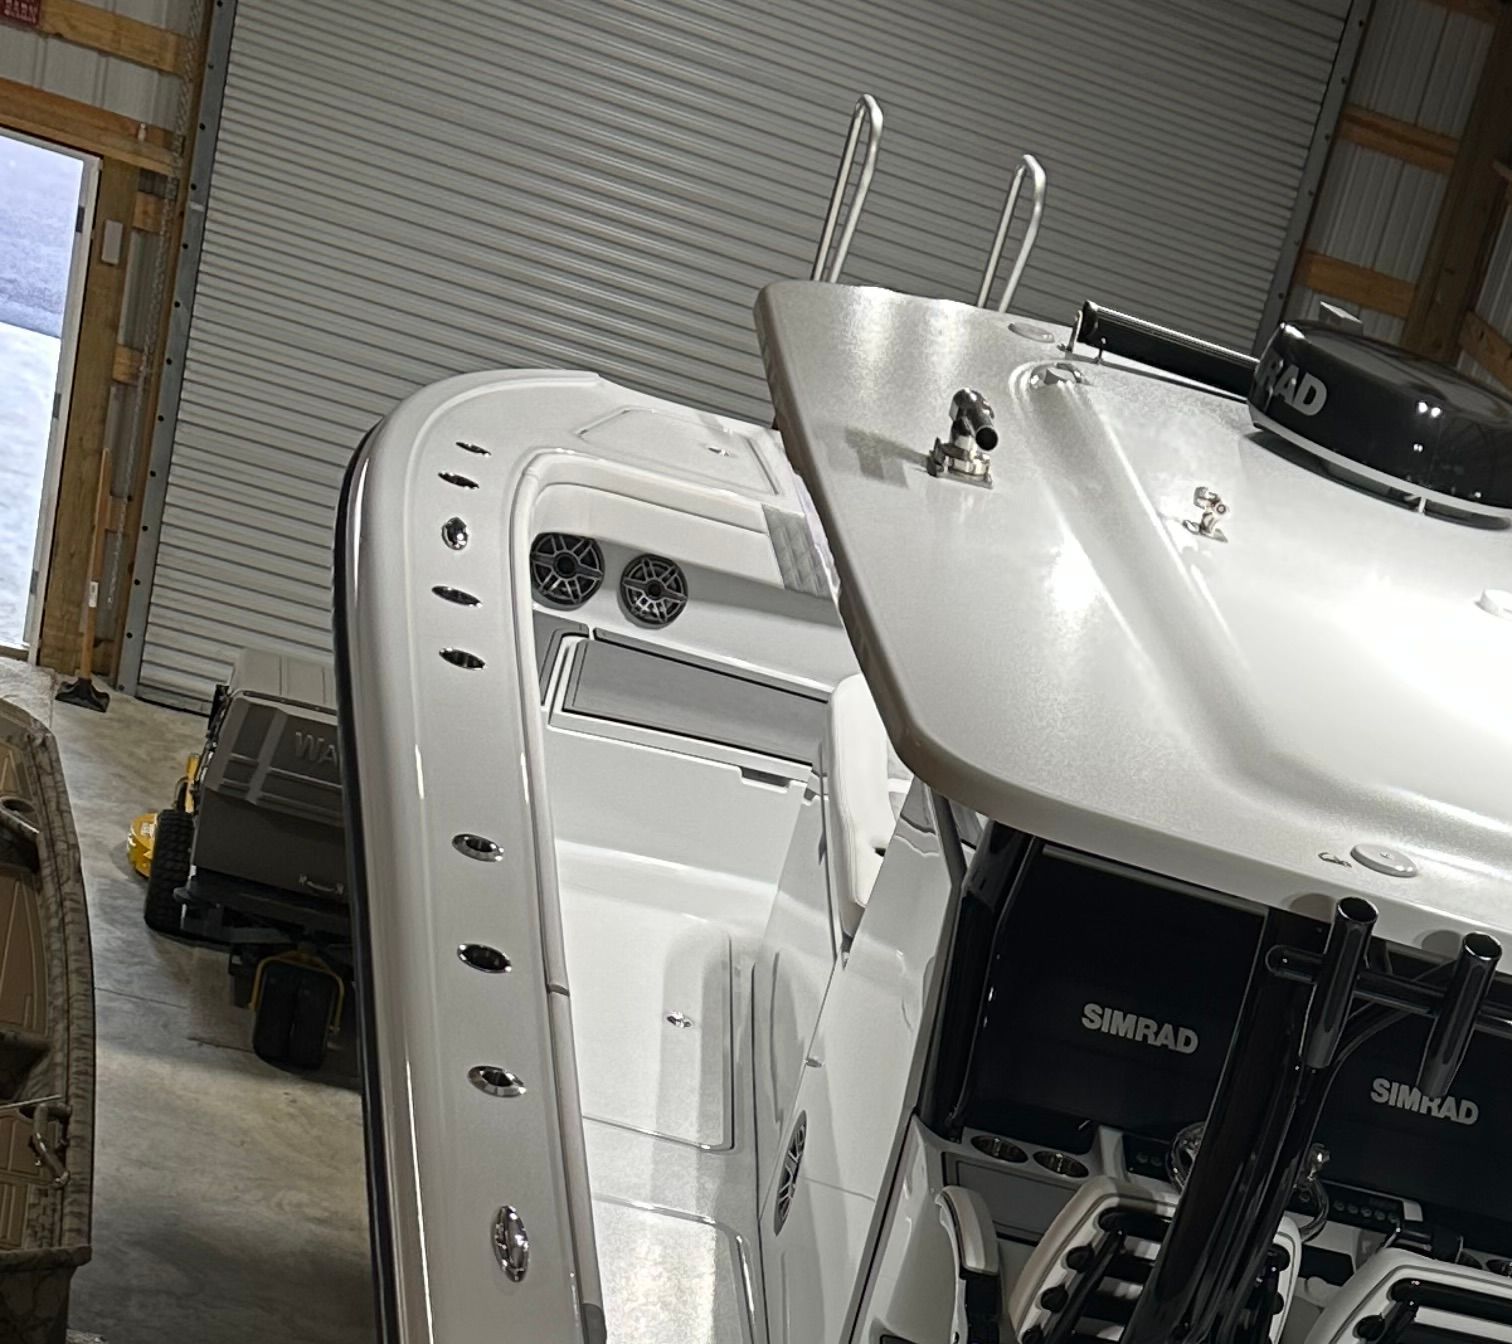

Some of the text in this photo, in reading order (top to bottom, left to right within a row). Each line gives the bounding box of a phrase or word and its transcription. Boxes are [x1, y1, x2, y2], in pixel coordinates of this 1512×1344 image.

[295, 731, 338, 768] WA
[1081, 1003, 1199, 1054] SIMRAD
[1370, 1078, 1479, 1125] SIMRAD
